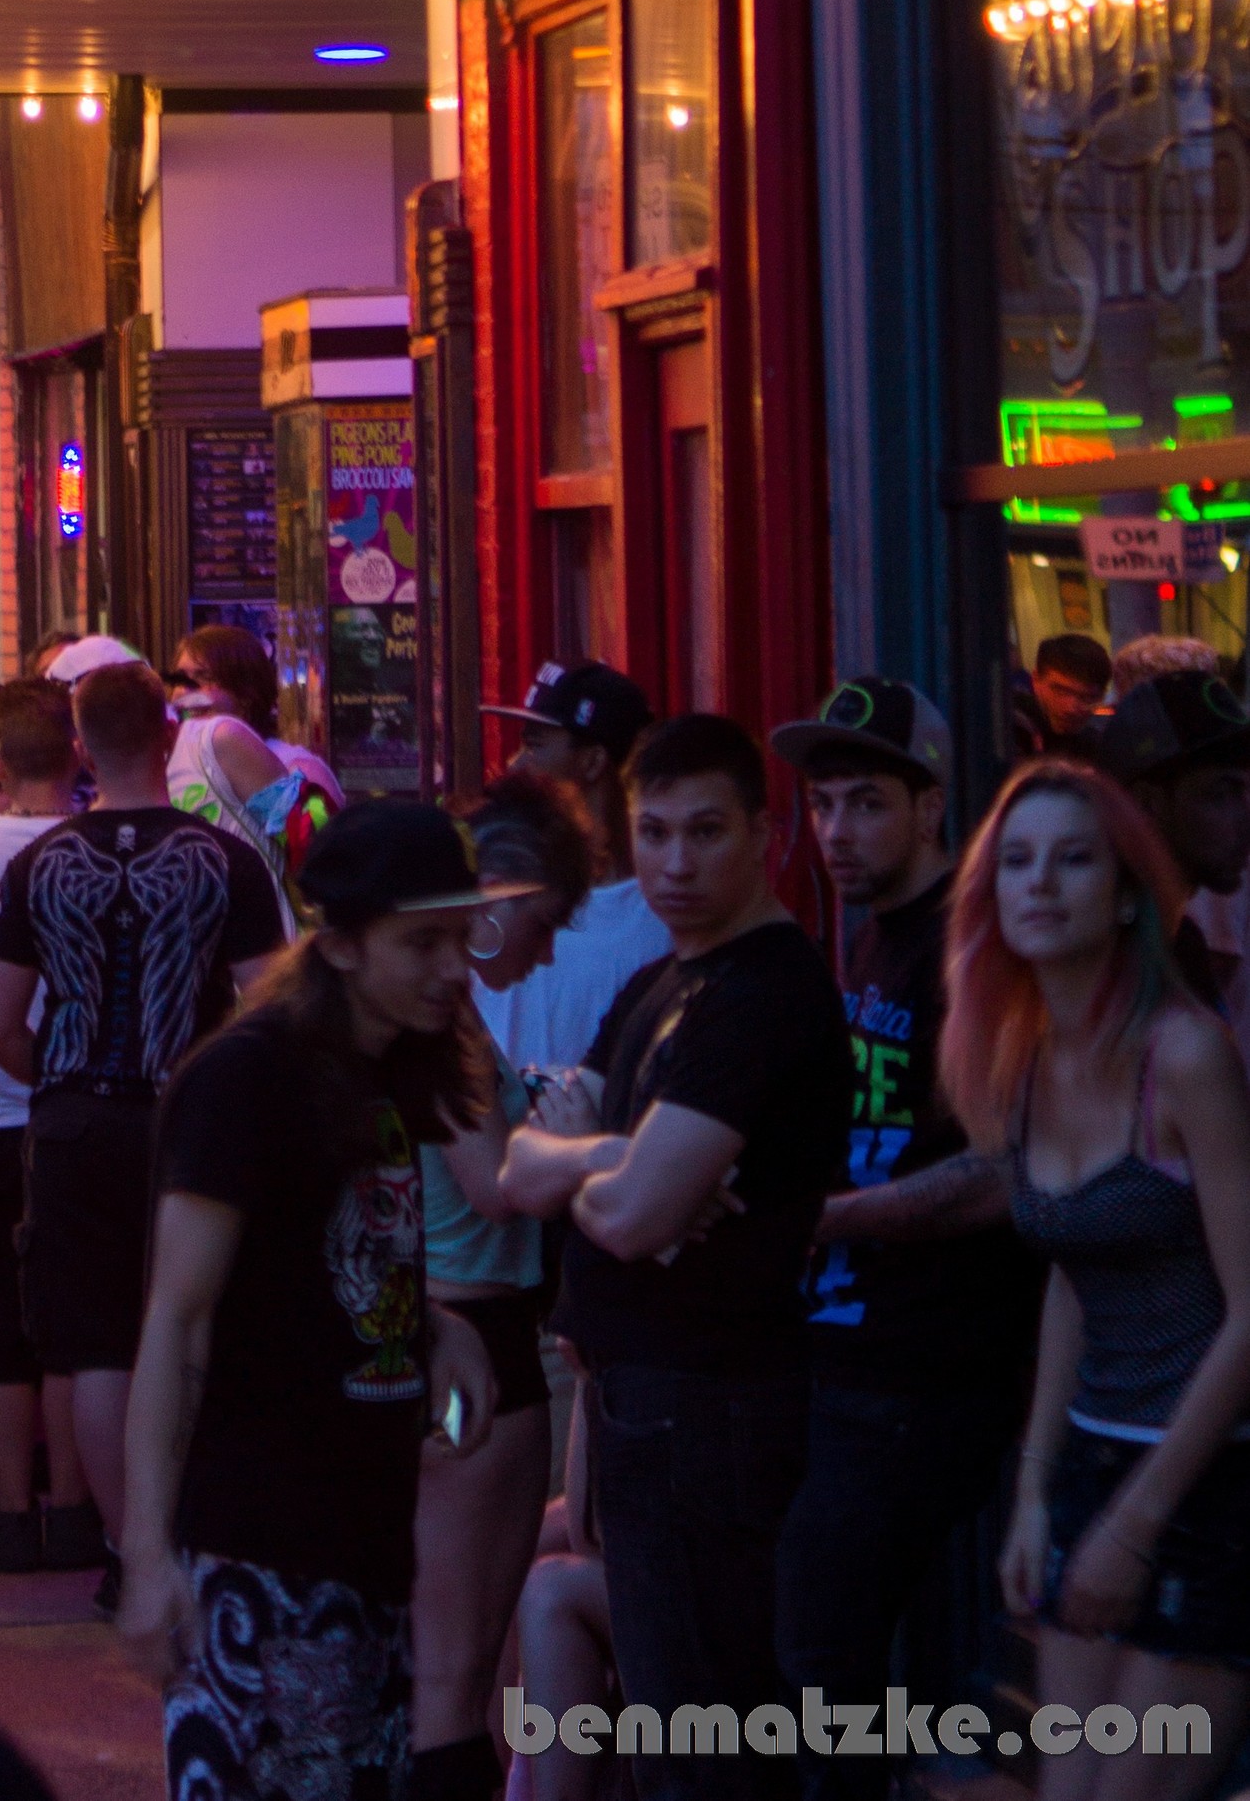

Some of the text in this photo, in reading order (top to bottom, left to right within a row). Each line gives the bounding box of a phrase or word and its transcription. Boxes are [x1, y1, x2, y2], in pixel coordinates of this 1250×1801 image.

[330, 421, 387, 445] PIGEONS
[330, 444, 402, 467] PING PONG
